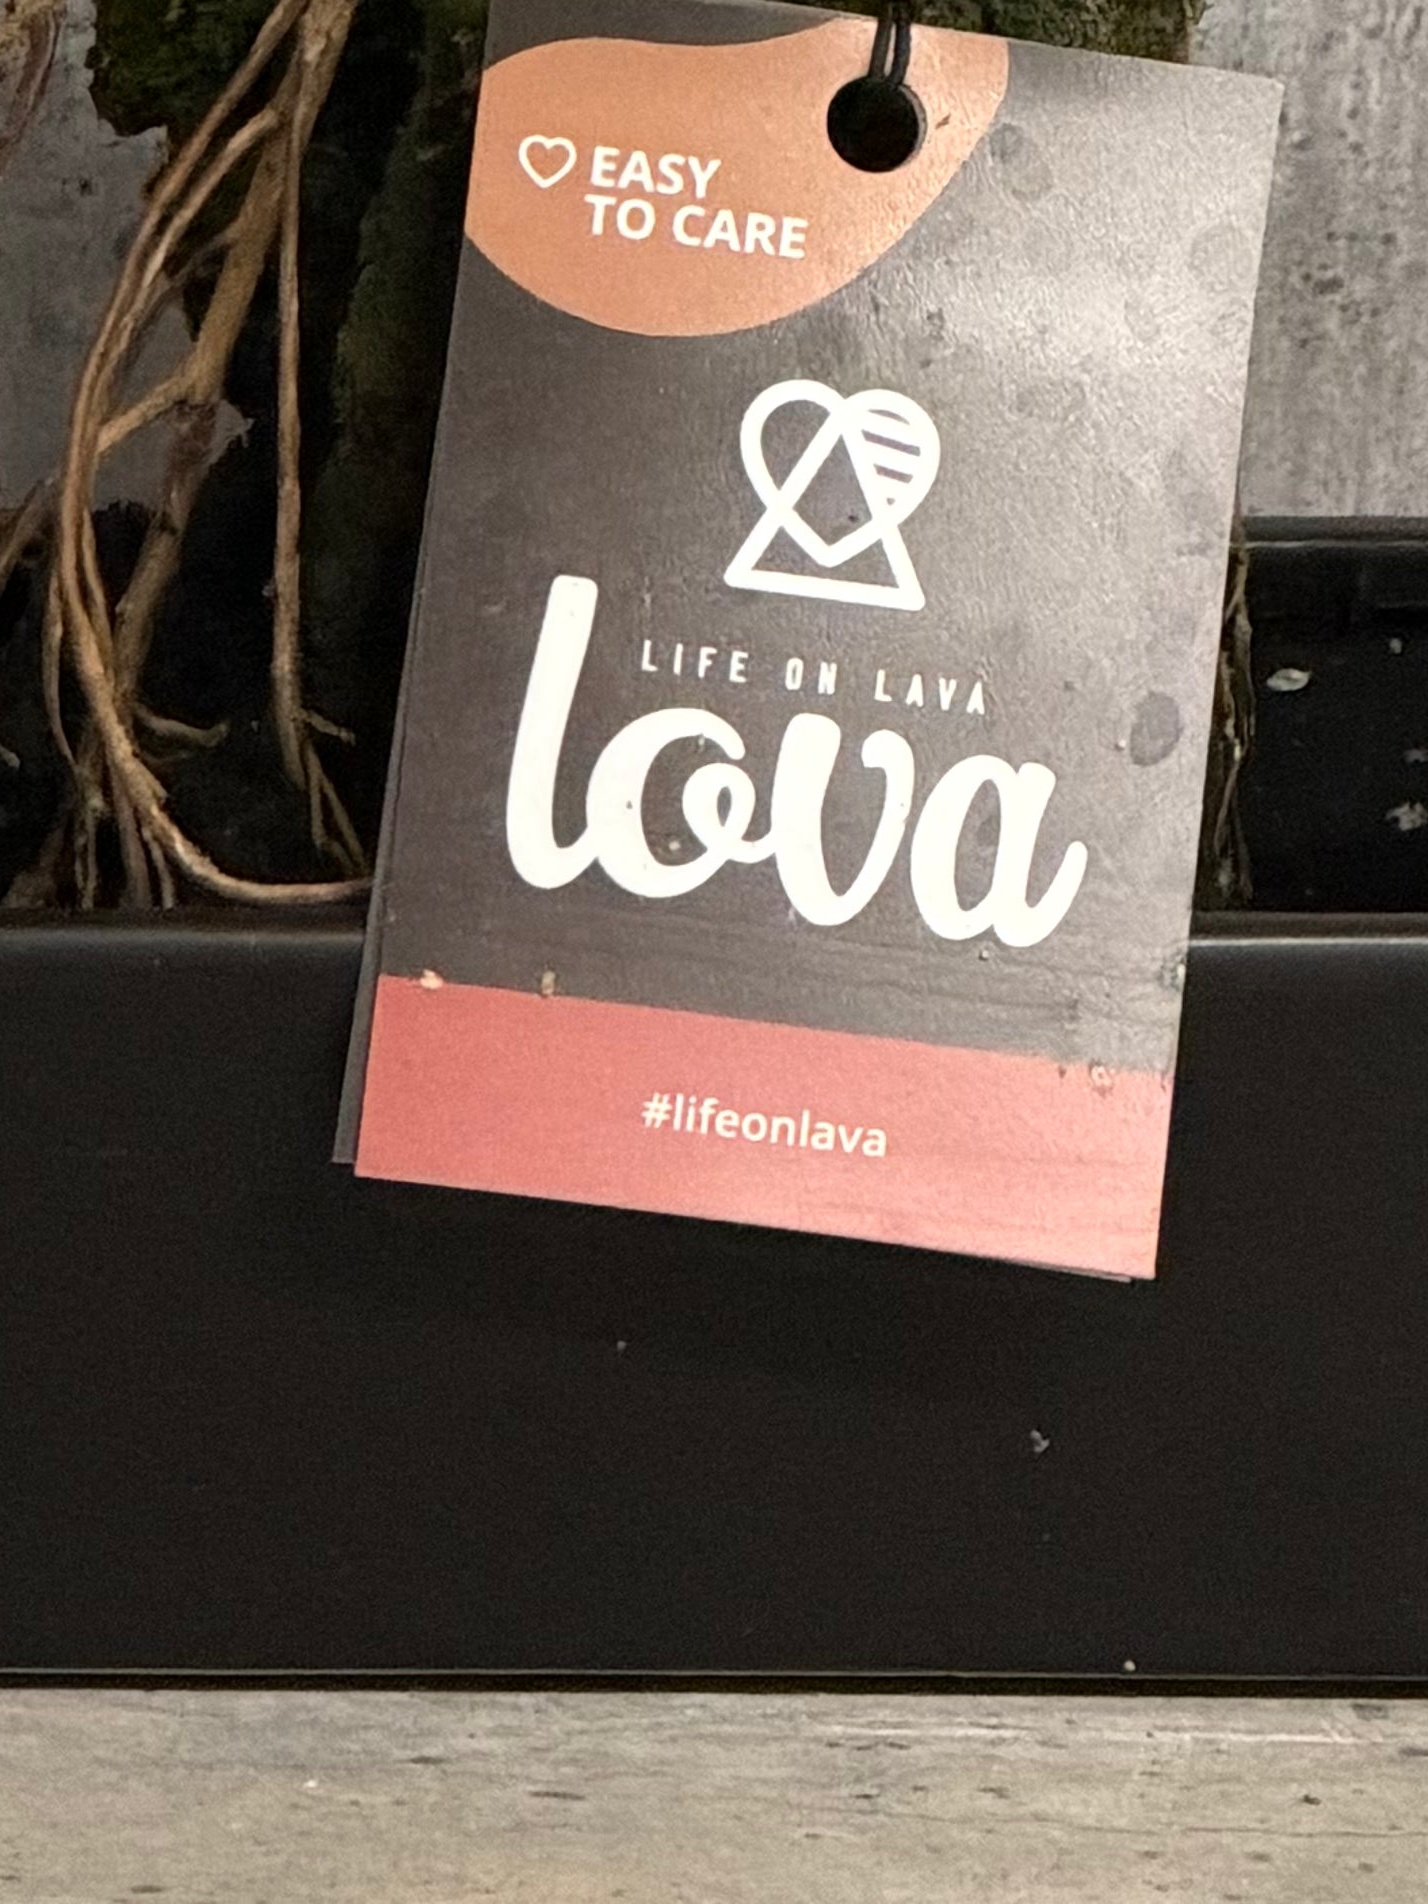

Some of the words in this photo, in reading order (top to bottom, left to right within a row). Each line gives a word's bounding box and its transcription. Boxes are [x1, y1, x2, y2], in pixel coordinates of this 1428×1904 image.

[589, 144, 722, 199] EASY
[583, 193, 657, 241] TO
[671, 204, 809, 259] CARE
[640, 639, 750, 684] LIFE
[784, 656, 838, 696] ON
[874, 669, 986, 716] LAVA
[505, 574, 1089, 948] lova
[640, 1091, 888, 1158] #lifeonlava
